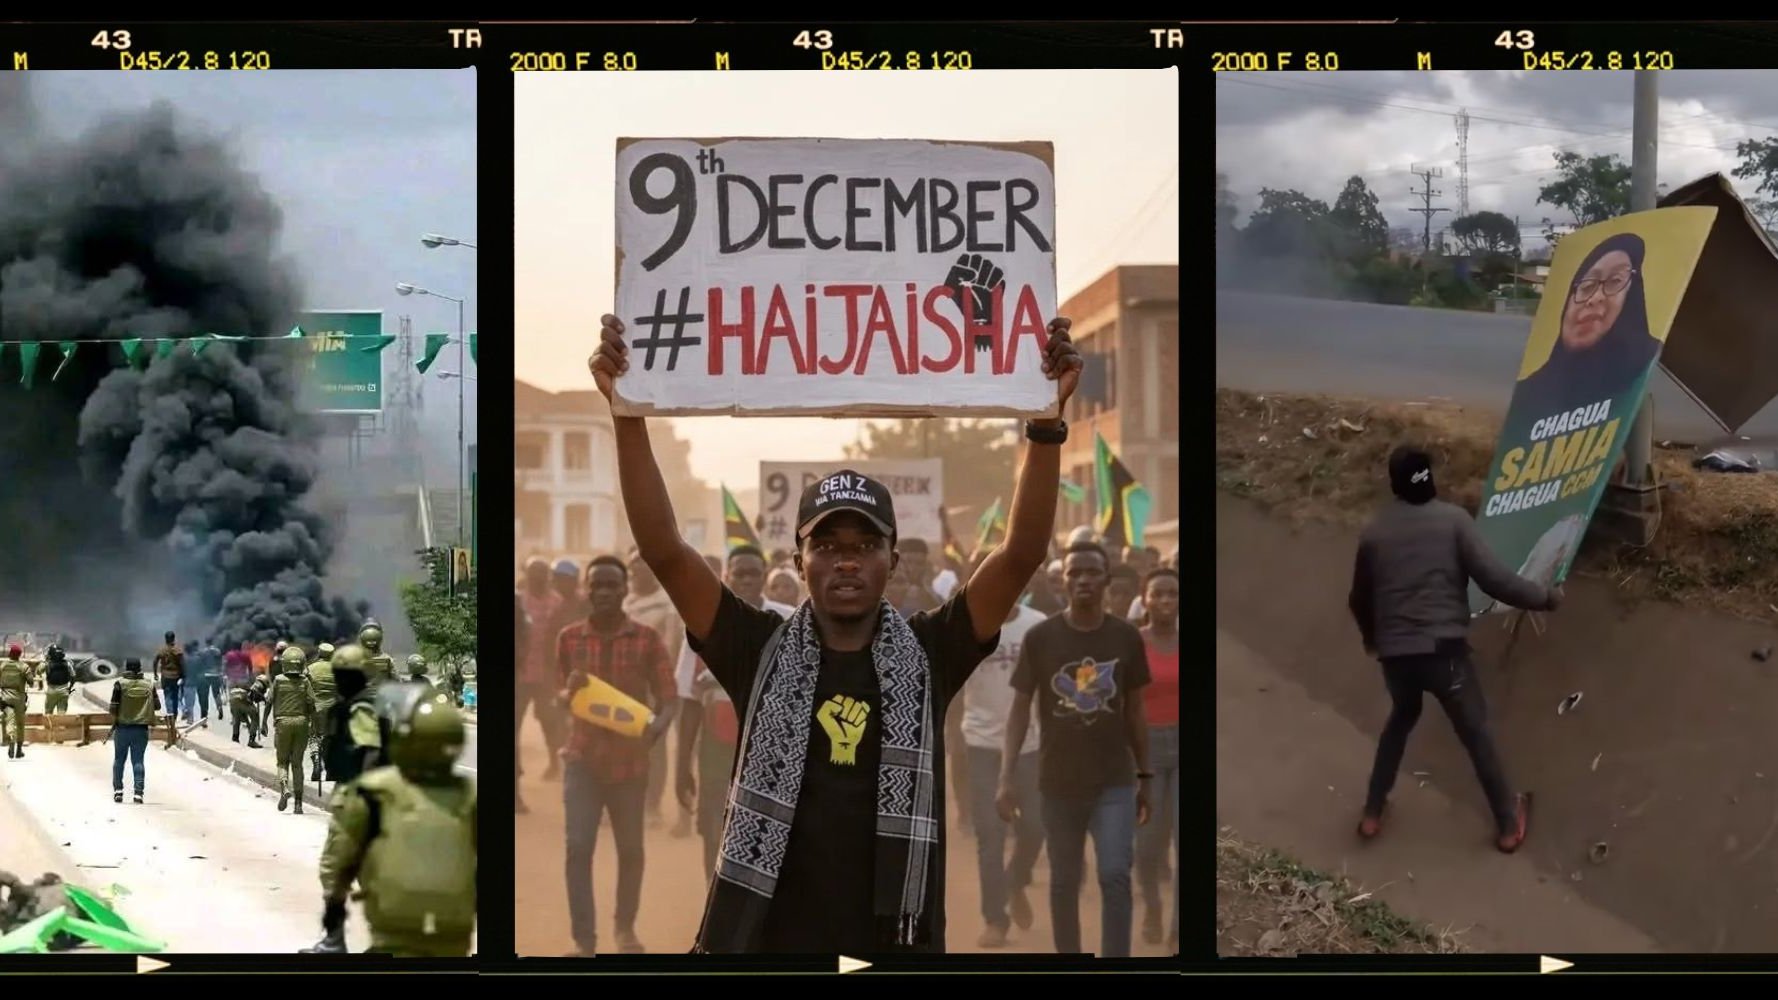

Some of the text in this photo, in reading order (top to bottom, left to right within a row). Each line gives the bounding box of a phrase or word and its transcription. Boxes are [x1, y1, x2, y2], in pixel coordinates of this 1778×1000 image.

[717, 173, 1052, 254] DECEMBER
[1531, 398, 1612, 441] CHAGUA
[1494, 417, 1621, 492] SAMIA
[820, 475, 851, 494] GEN
[856, 476, 867, 491] Z
[1485, 463, 1604, 516] CHAGUA CCM
